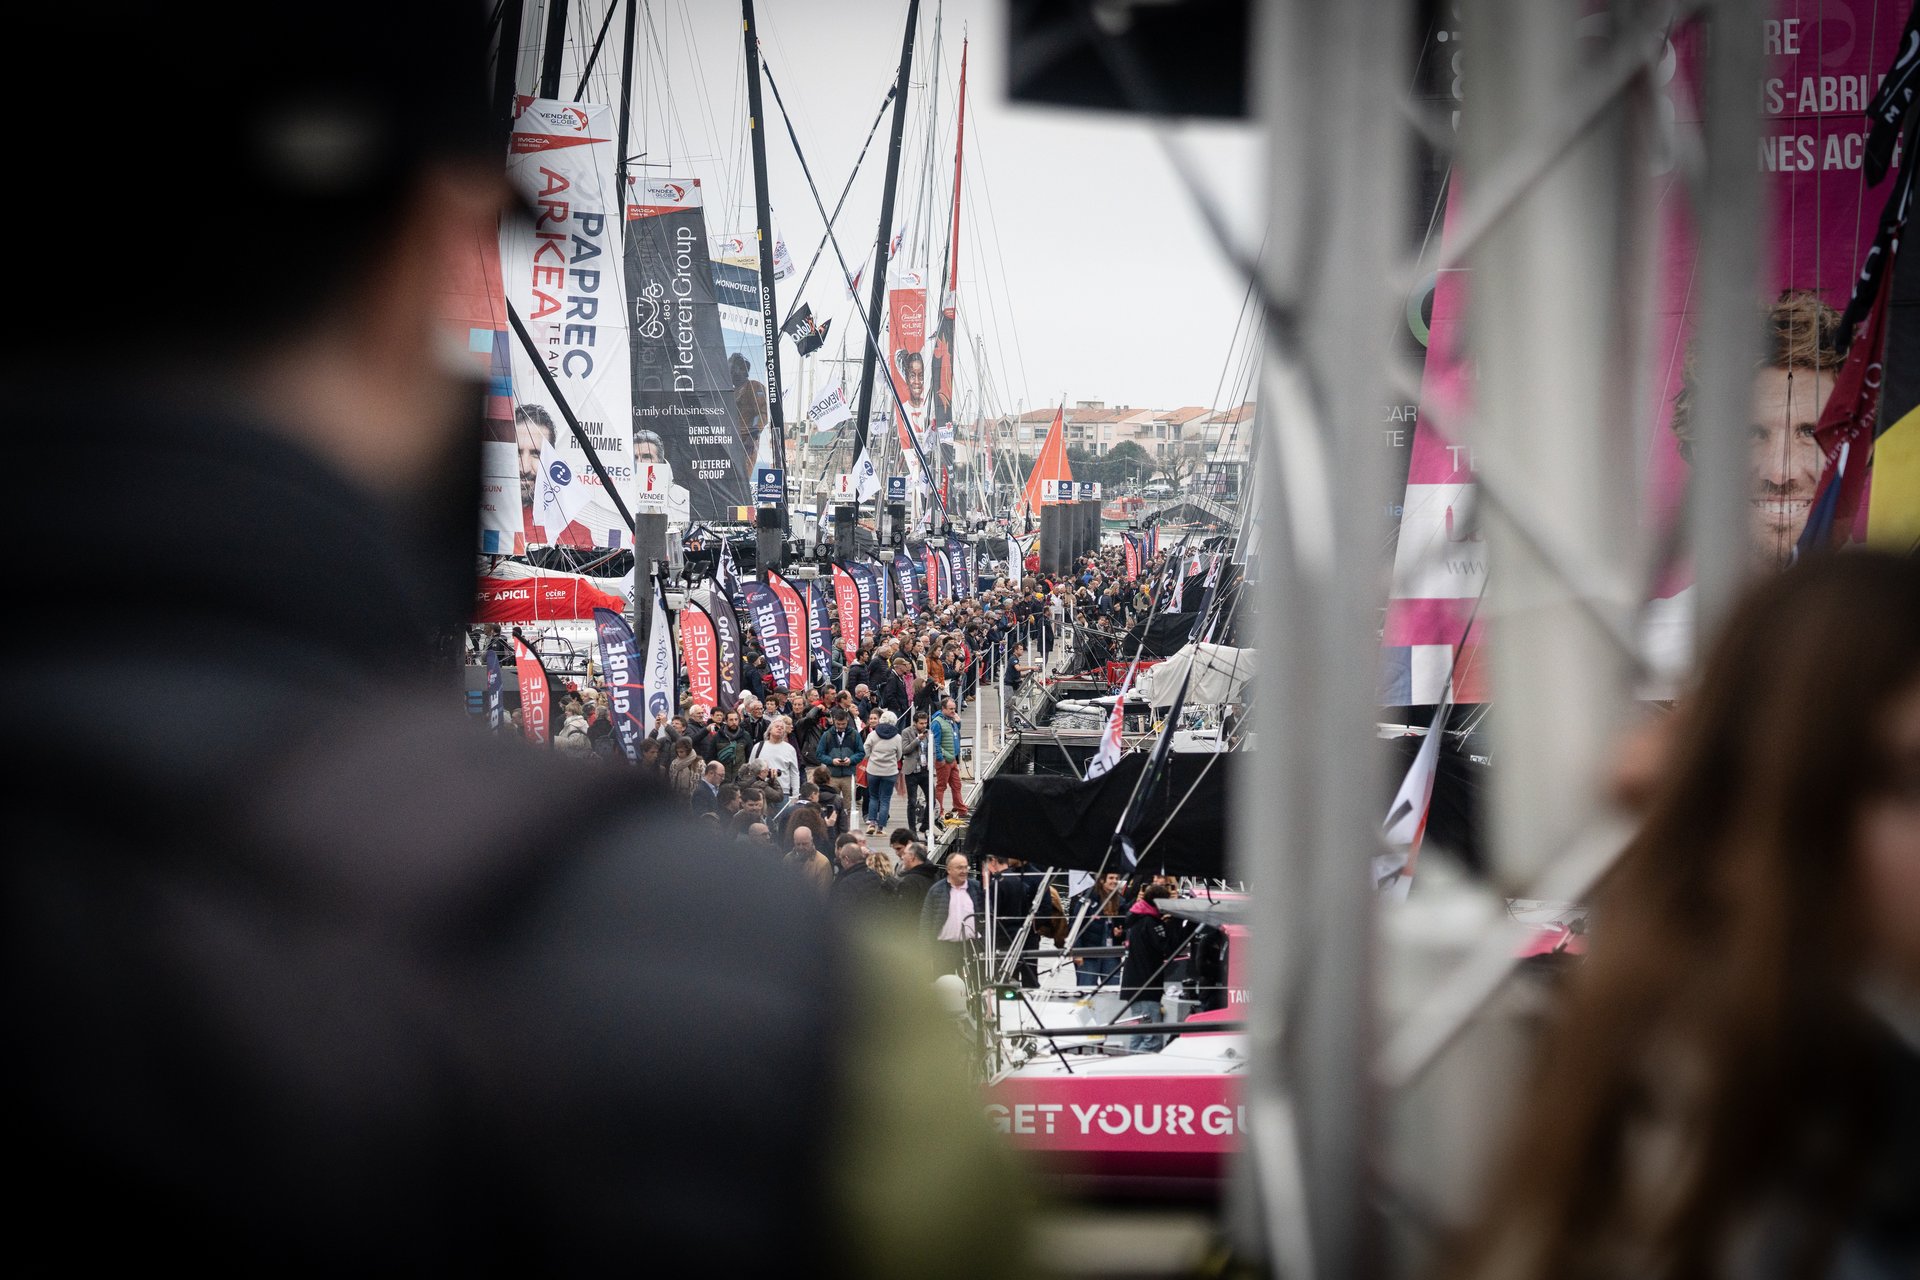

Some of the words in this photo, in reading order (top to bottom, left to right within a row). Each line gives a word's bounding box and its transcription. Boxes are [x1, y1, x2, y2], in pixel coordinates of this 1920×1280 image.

[1763, 18, 1801, 56] RE
[540, 112, 574, 120] VENDÉE
[1758, 133, 1815, 172] NES
[529, 166, 570, 320] ARKEA
[715, 279, 758, 294] MONNOYEUR
[562, 211, 605, 379] PAPREC
[763, 286, 771, 316] GOING
[663, 299, 671, 320] 1805
[765, 318, 774, 356] FURTHER
[548, 323, 561, 378] TEAM
[767, 358, 777, 403] TOGETHER
[632, 405, 660, 418] family
[661, 405, 674, 416] of
[674, 405, 725, 415] businesses
[578, 421, 603, 436] OANN
[688, 426, 710, 434] DENIS
[711, 426, 725, 434] VAN
[688, 436, 733, 445] WEYNBERGH
[692, 460, 731, 469] D'IETEREN
[698, 470, 725, 480] GROUP
[640, 492, 664, 500] VENDÉE
[494, 589, 530, 601] APICIL
[1229, 990, 1252, 1003] TAN
[984, 1104, 1063, 1134] GET
[1070, 1103, 1196, 1135] YOUR
